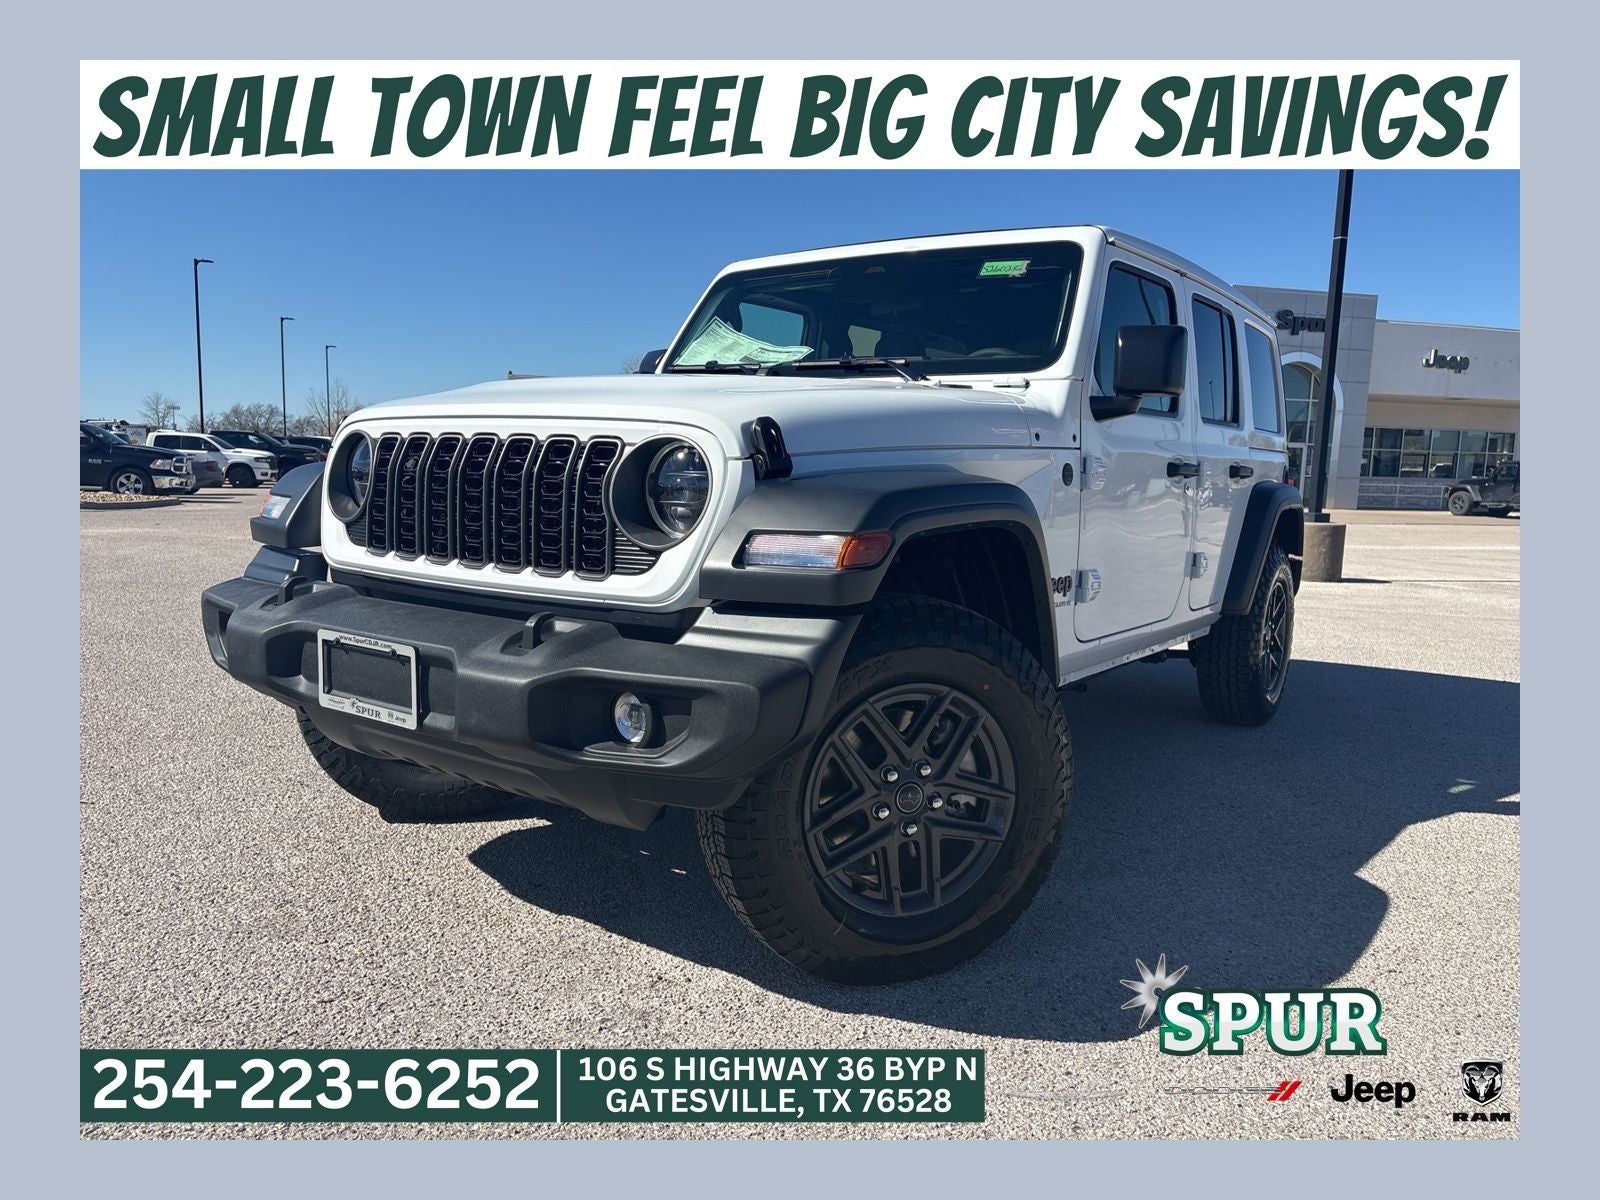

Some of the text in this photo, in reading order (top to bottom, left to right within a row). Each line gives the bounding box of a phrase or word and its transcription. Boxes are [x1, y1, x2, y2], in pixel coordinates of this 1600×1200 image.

[1277, 309, 1326, 335] Spu
[1423, 349, 1469, 374] Jeep
[1051, 575, 1072, 597] eep
[355, 705, 382, 719] SPUR
[776, 755, 801, 858] ROAD
